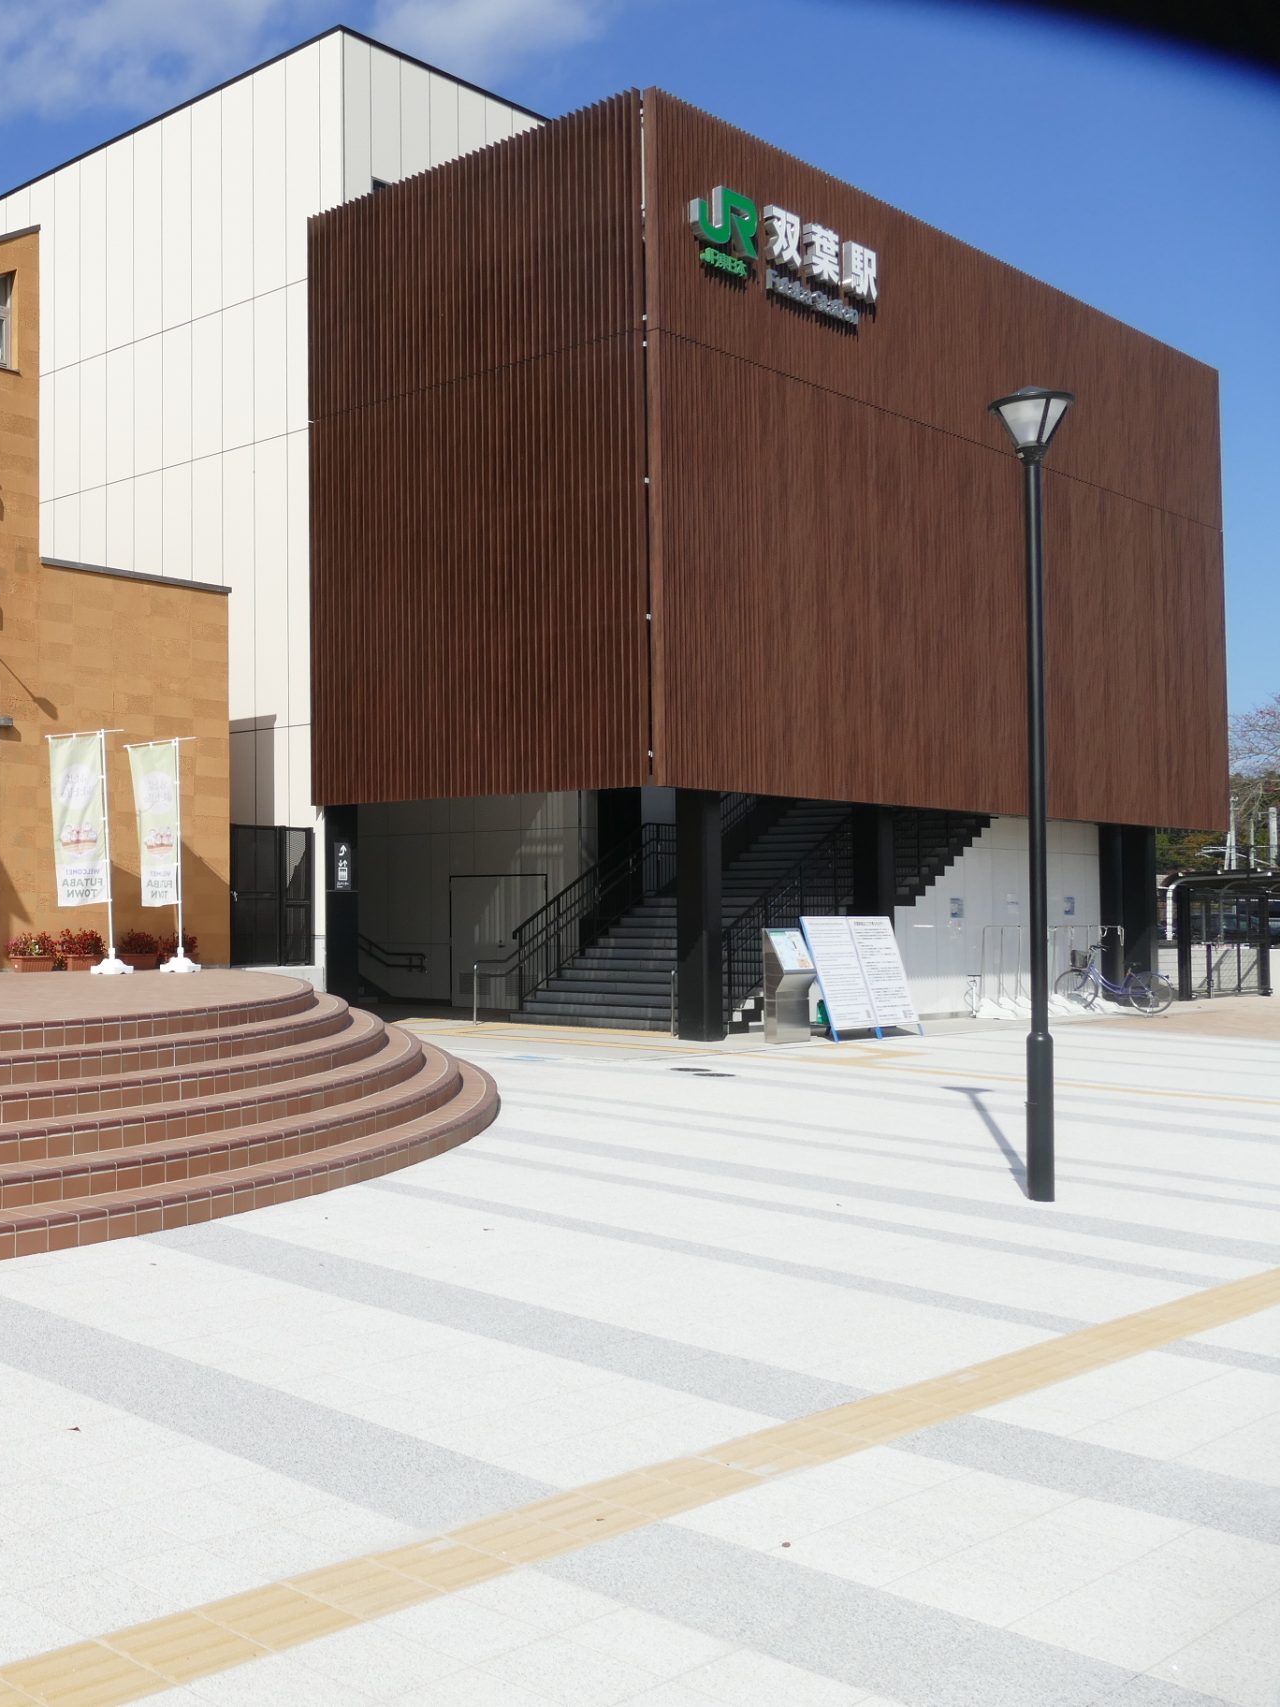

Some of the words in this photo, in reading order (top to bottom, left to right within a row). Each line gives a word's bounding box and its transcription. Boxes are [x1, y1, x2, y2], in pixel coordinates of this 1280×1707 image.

[689, 185, 758, 260] JR
[764, 204, 877, 303] 双葉駅
